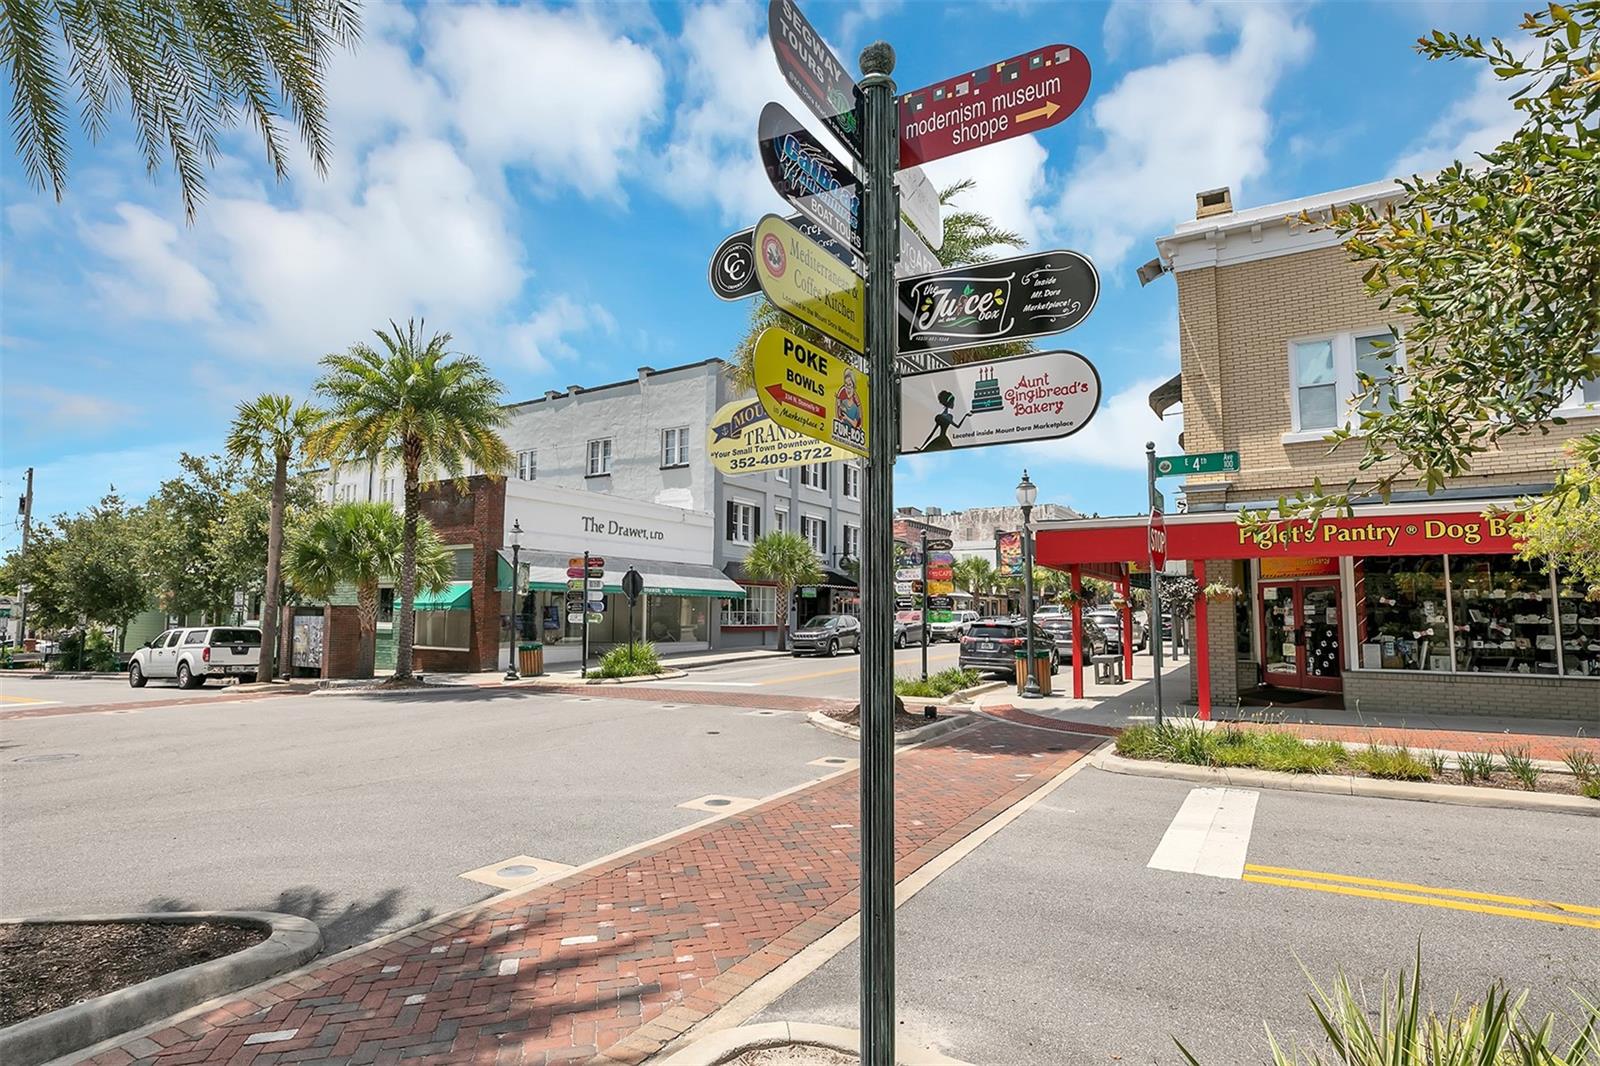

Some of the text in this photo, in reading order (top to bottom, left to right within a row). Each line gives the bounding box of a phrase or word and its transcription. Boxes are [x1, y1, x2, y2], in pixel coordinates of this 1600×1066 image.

[780, 18, 824, 83] TOURS
[782, 0, 841, 81] SEGWAY
[905, 100, 986, 139] modernism
[992, 77, 1060, 112] museum
[952, 115, 1008, 144] shoppe
[810, 198, 861, 248] BOAT TOURS
[789, 239, 849, 295] Mediterranean
[793, 269, 855, 321] Coffee Kitchen
[923, 284, 939, 296] the
[1044, 289, 1061, 297] Dora
[919, 288, 993, 330] Juice
[978, 310, 1000, 321] box
[784, 337, 828, 376] POKE
[786, 368, 825, 396] BOWLS
[1014, 373, 1050, 389] Aunt
[1004, 382, 1089, 405] Gingibread's
[779, 408, 818, 428] Marketplace
[820, 422, 825, 431] 2
[1014, 401, 1065, 417] Bakery
[744, 423, 804, 446] TRANS
[952, 420, 1075, 440] Located inside Mount Dora Marketplace
[730, 446, 832, 470] 352-409-8722
[732, 446, 753, 456] Small
[755, 443, 776, 453] Town
[777, 438, 820, 449] Downtown
[1184, 458, 1189, 466] E
[1223, 460, 1234, 468] 100
[581, 516, 605, 533] The
[1323, 524, 1399, 547] Pantry
[1424, 520, 1481, 544] Dog
[1150, 528, 1165, 553] STOP
